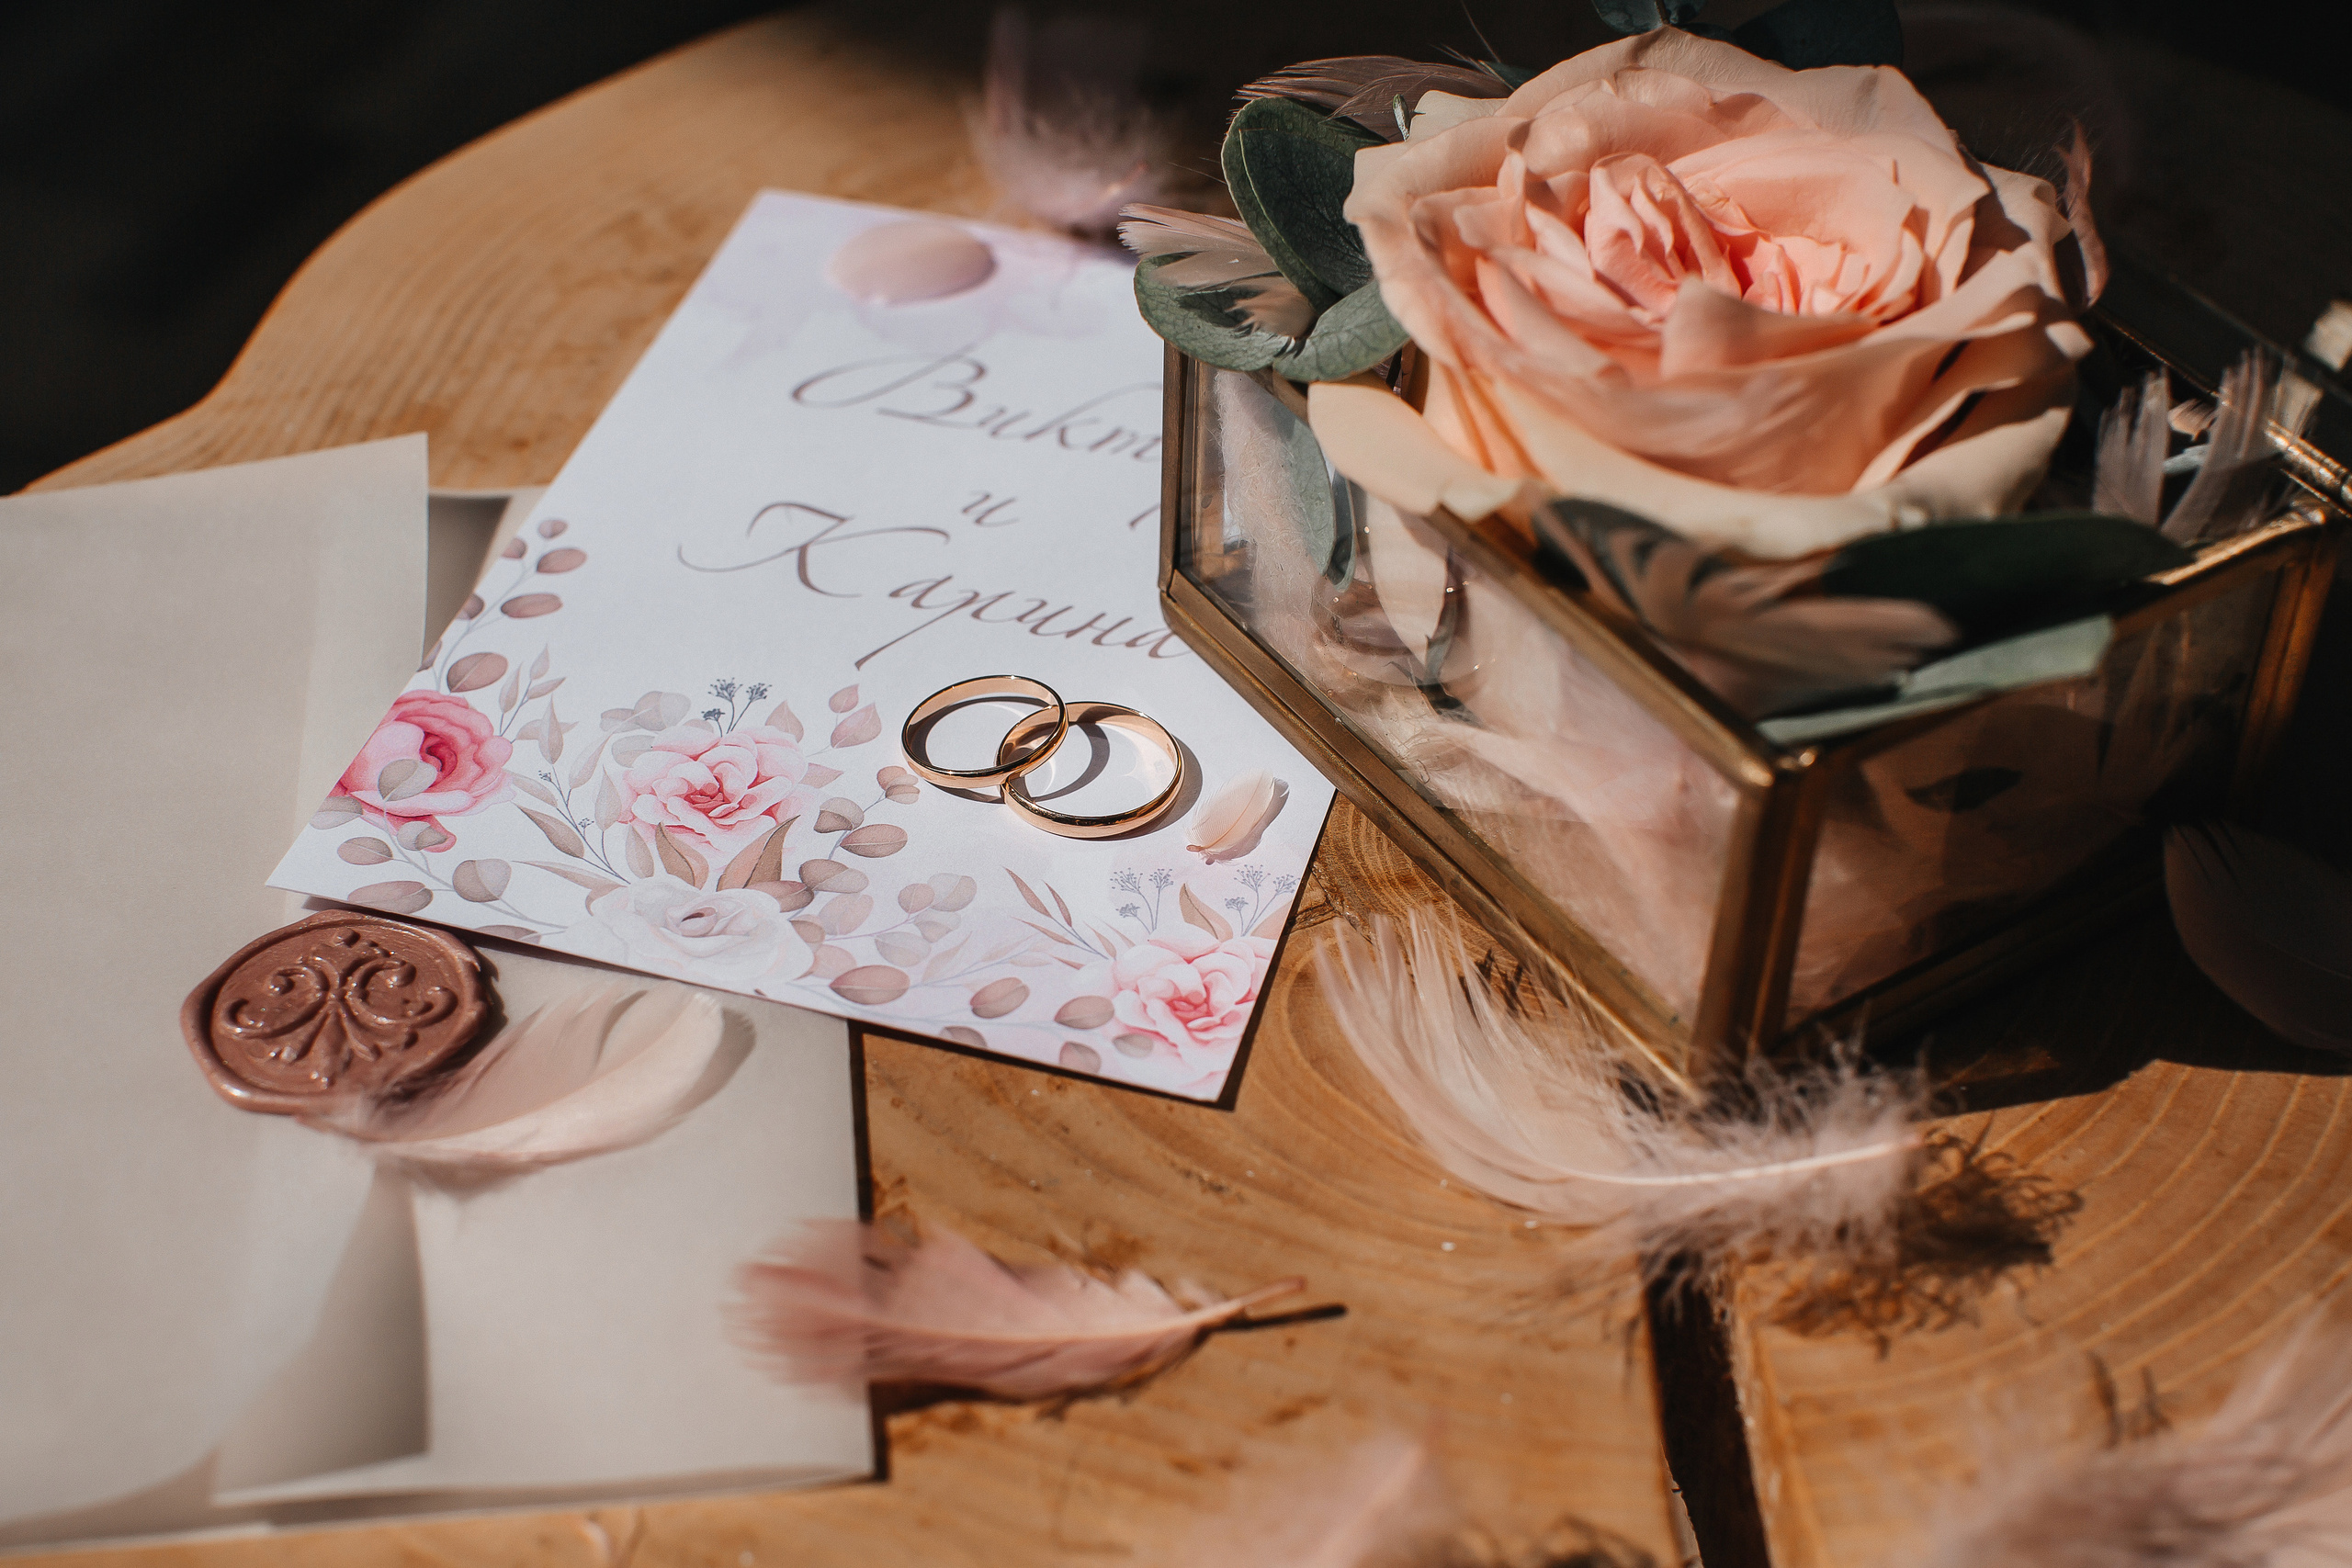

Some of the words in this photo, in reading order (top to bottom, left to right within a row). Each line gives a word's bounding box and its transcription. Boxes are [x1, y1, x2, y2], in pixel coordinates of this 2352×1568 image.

[788, 341, 1162, 530] Викт
[961, 490, 1020, 527] и
[677, 502, 1193, 671] Карина
